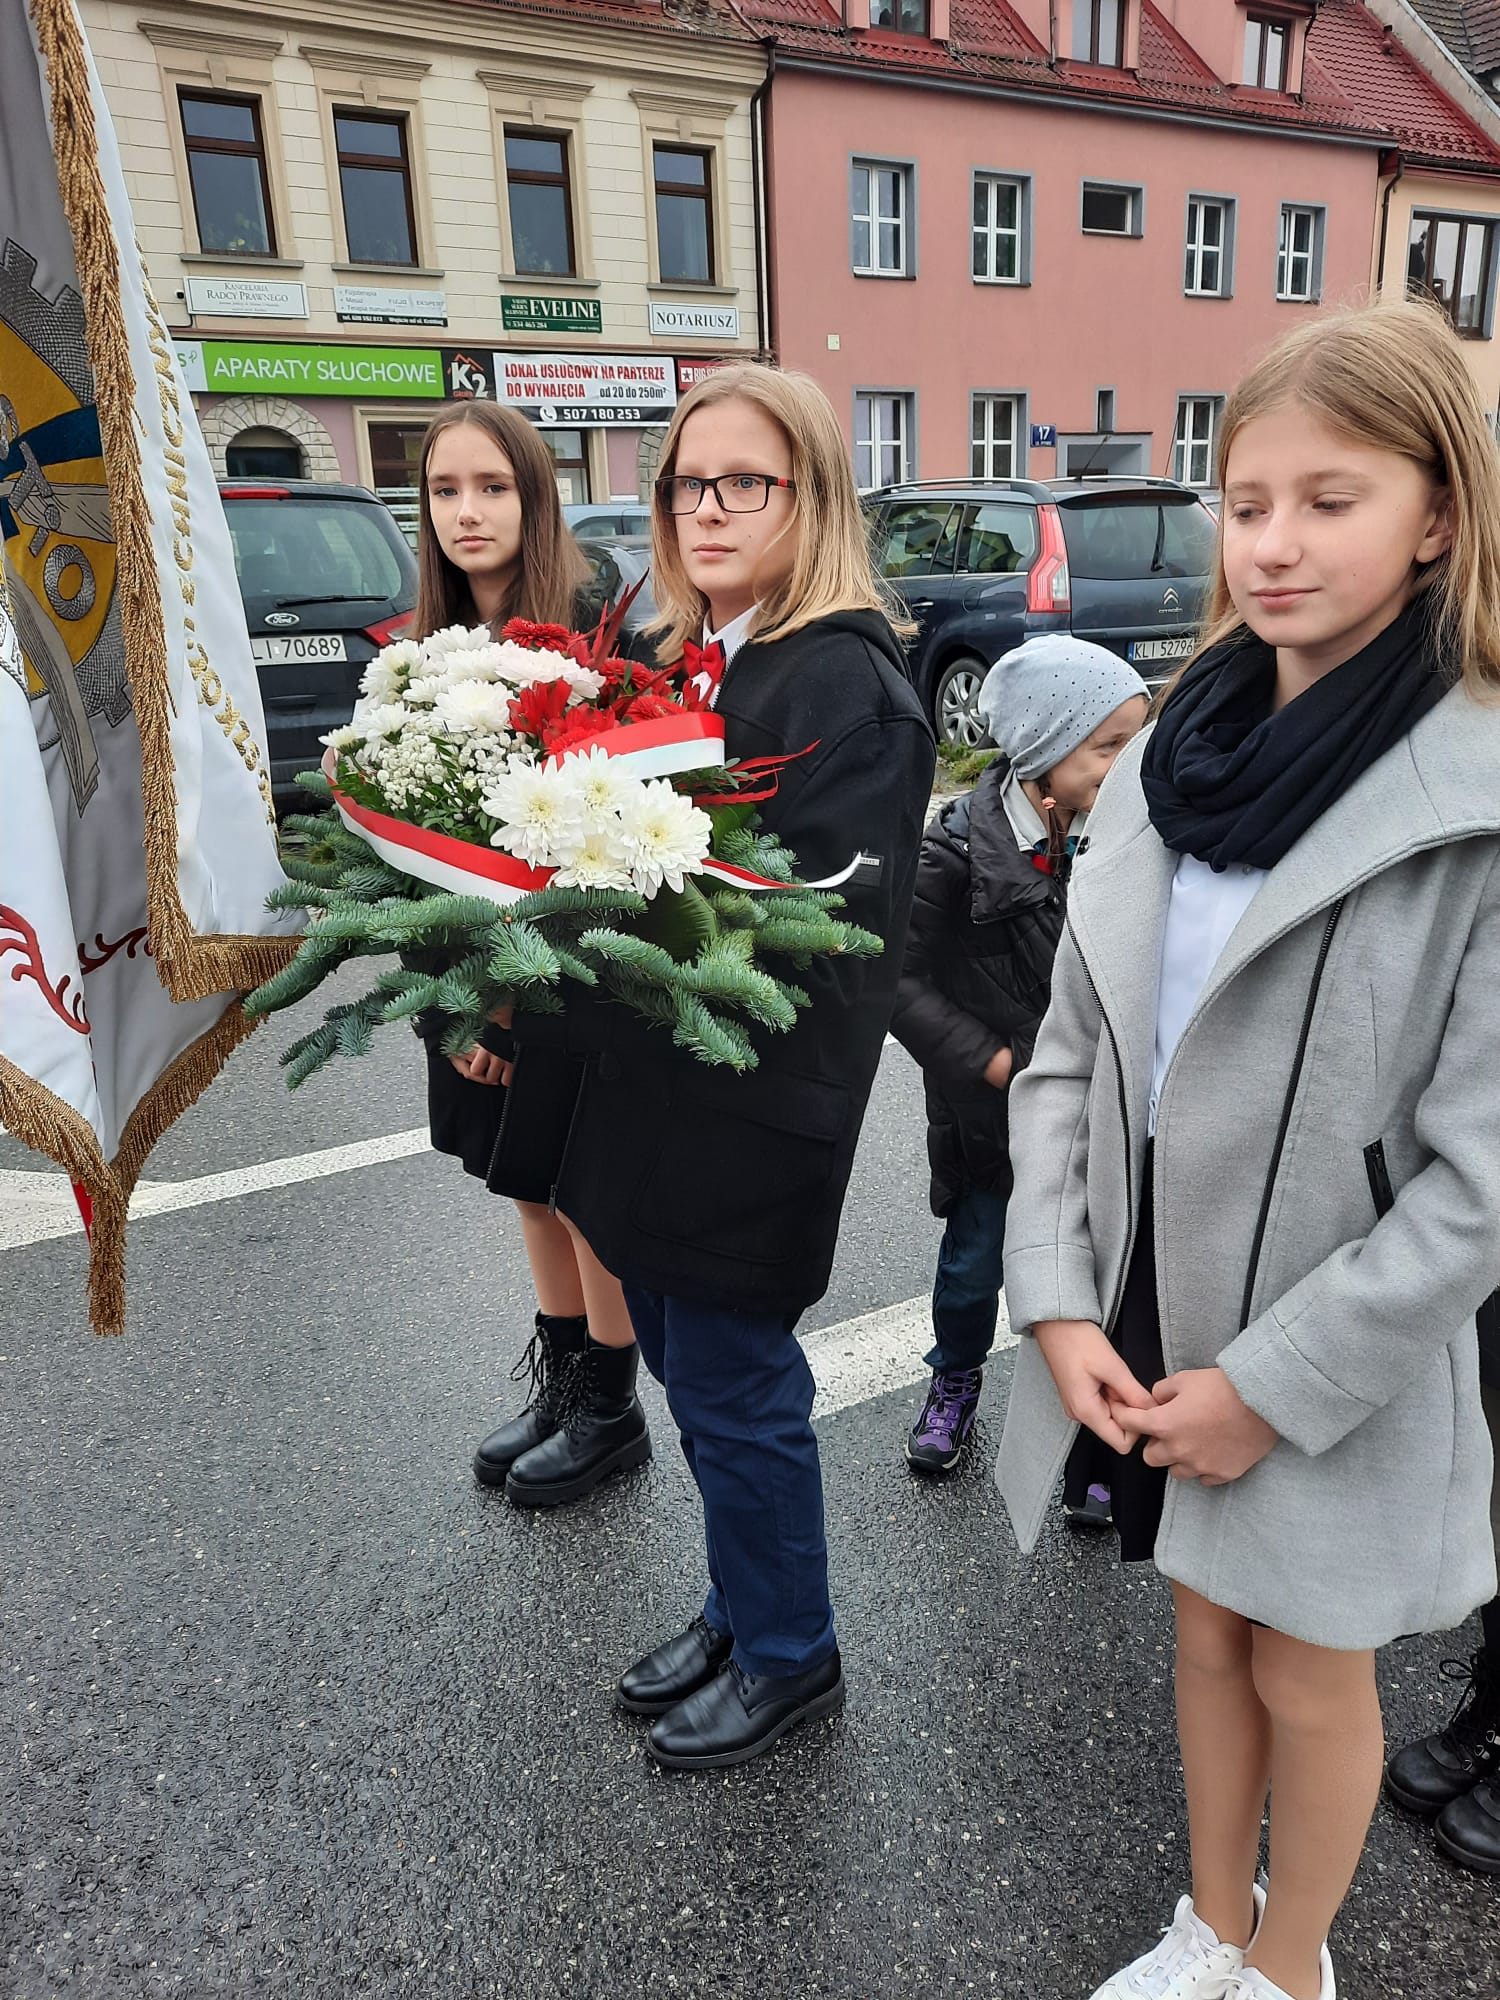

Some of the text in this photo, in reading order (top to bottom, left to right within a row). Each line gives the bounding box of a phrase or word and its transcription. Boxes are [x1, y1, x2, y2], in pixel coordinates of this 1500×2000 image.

[206, 289, 289, 303] RADCY PRAWNEGO
[224, 282, 269, 292] KANCELARIA
[529, 299, 600, 319] EVELINE
[656, 311, 734, 329] NOTARIUSZ
[213, 357, 311, 379] APARATY
[316, 360, 437, 384] SŁUCHOWE
[505, 363, 666, 381] LOKAL USŁUGOWY NA PARTERZE
[451, 362, 488, 398] K2
[506, 383, 667, 400] DO WYNAJĘCIA od 20 do 250m²
[563, 408, 641, 420] 507 180 253
[1039, 425, 1051, 441] 17
[272, 615, 293, 624] Ford
[281, 637, 341, 658] 70689
[1134, 640, 1194, 659] KLI 52796
